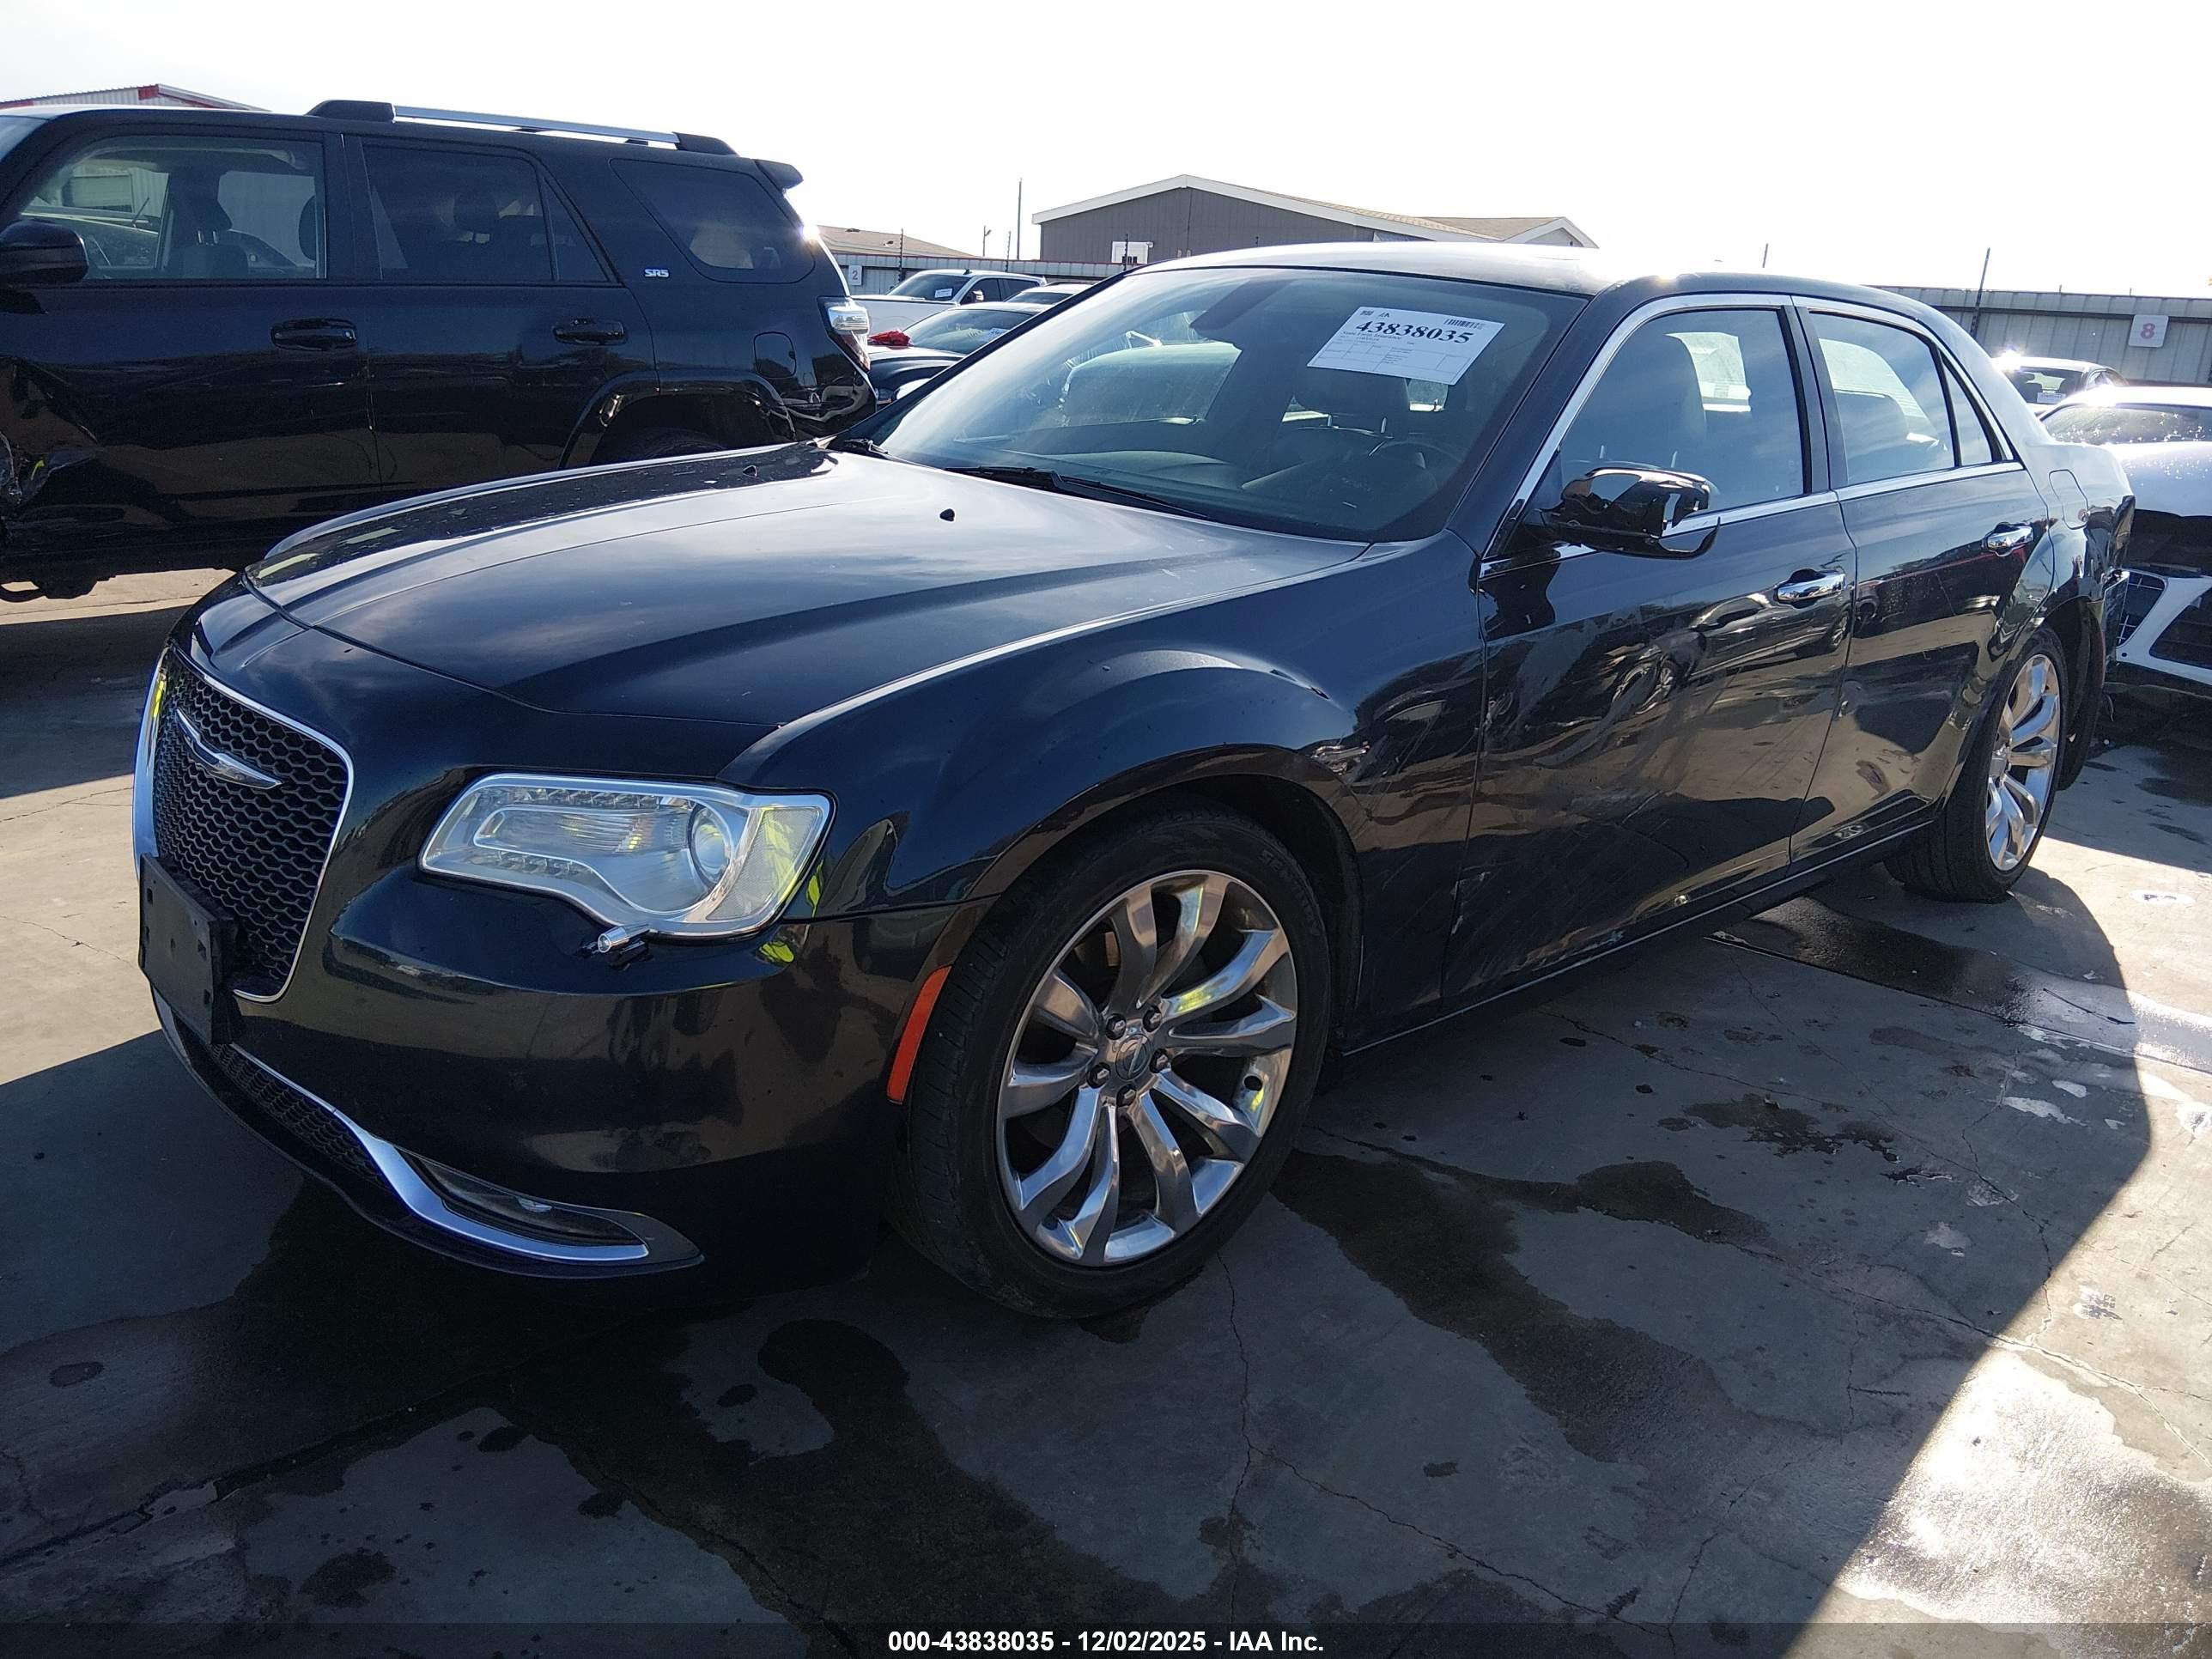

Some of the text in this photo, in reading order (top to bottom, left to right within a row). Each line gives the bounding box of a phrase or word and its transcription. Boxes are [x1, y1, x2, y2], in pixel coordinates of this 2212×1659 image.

[645, 269, 669, 277] SR5
[852, 270, 859, 280] 2
[1355, 320, 1474, 344] 43838035
[2140, 323, 2155, 339] 8
